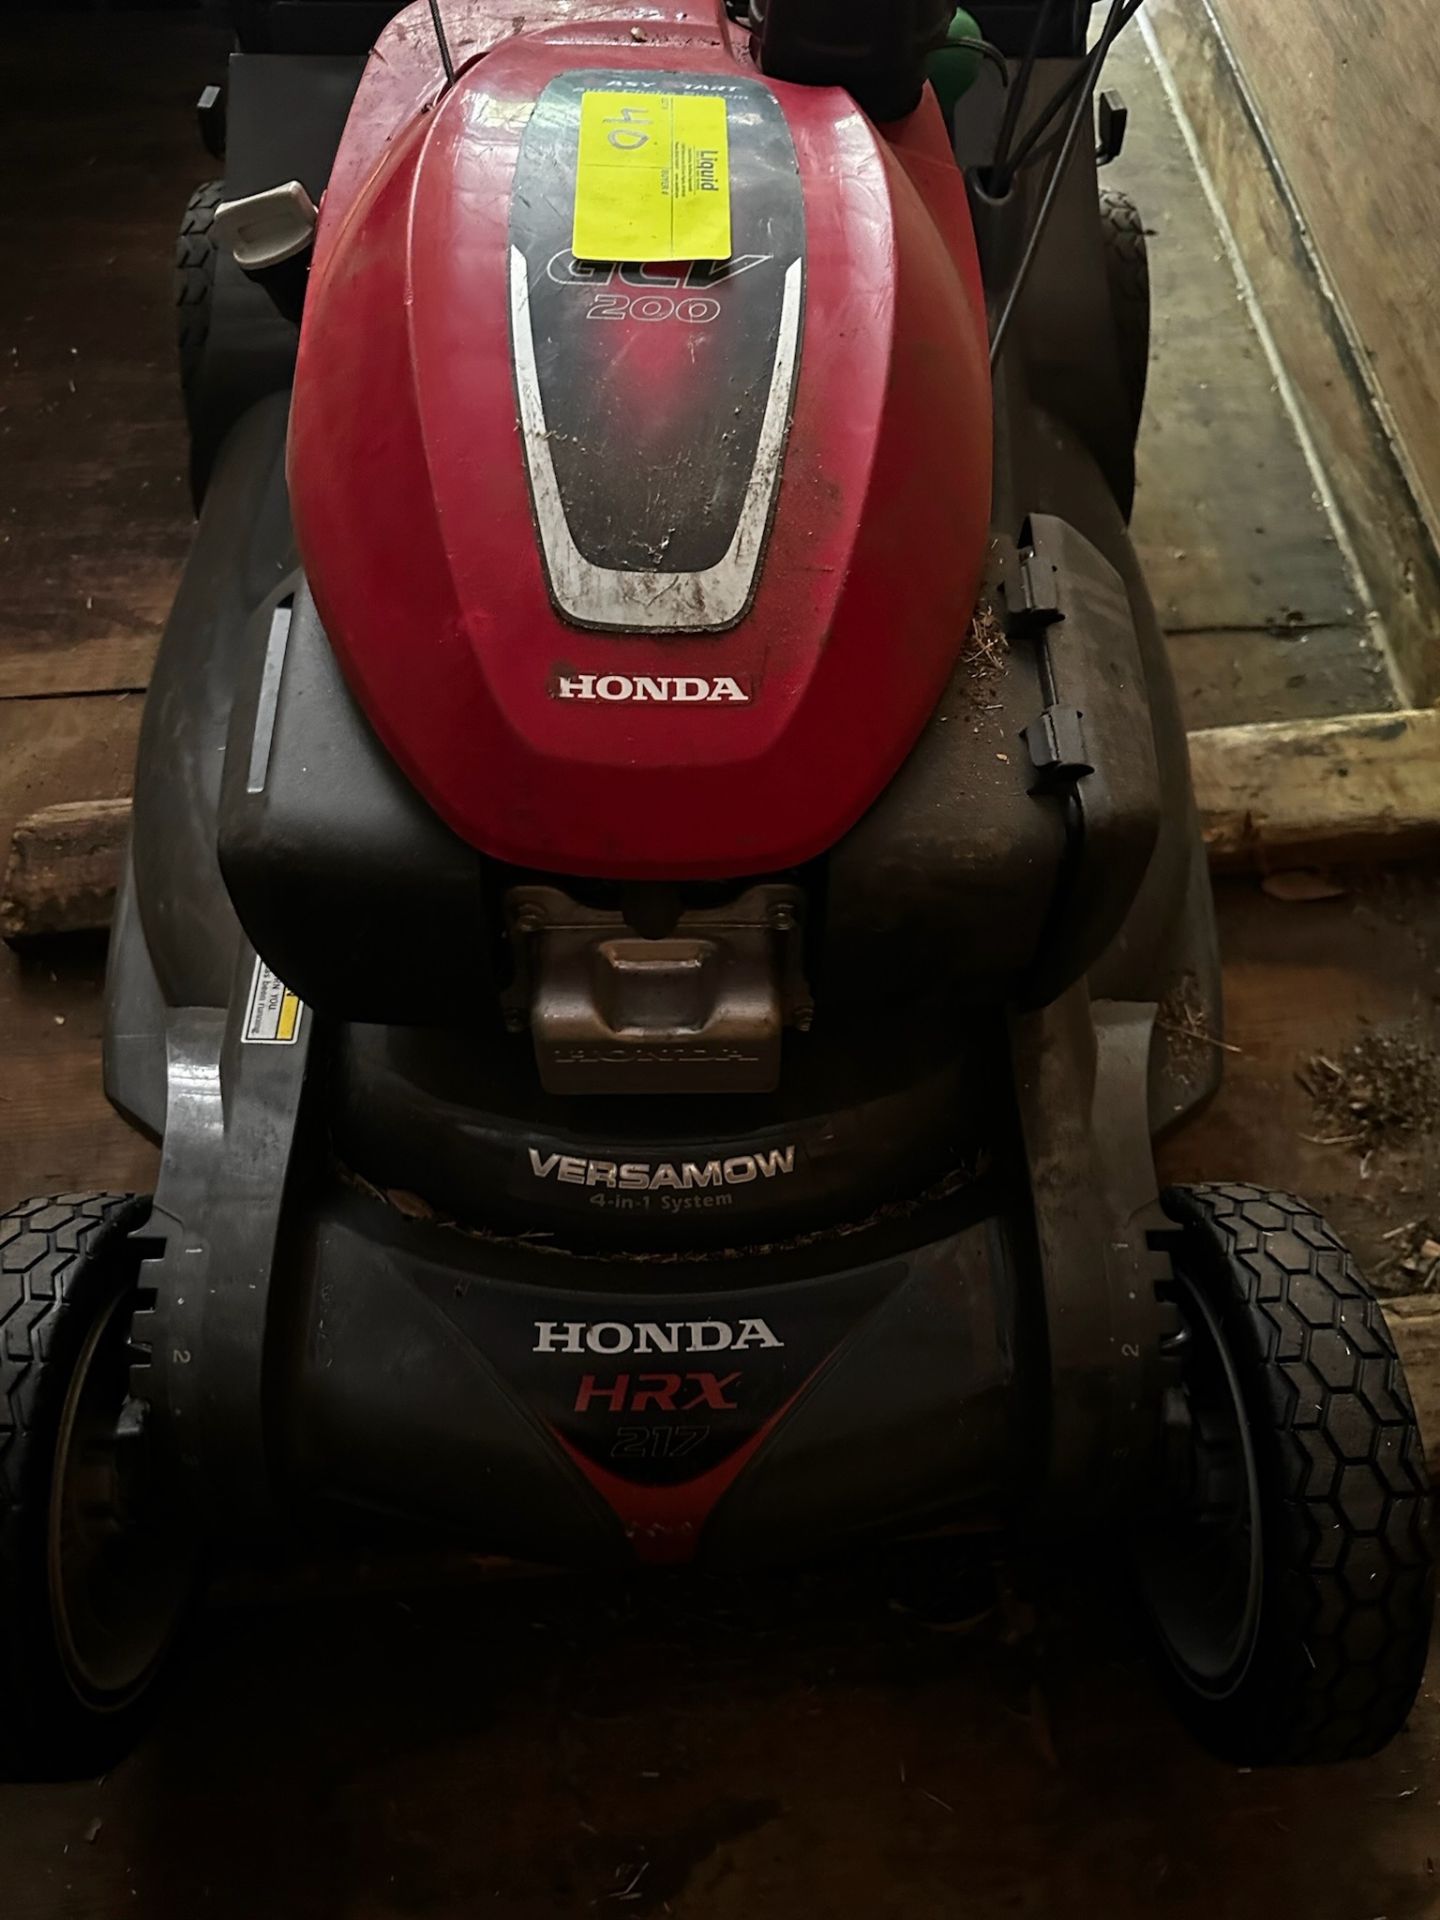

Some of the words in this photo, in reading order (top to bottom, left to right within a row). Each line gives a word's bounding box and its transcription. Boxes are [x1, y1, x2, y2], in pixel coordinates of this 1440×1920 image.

[601, 107, 653, 151] 40
[699, 150, 719, 192] Liquid
[586, 294, 720, 323] 200
[558, 674, 749, 702] HONDA
[268, 995, 278, 1010] YOU
[553, 1048, 759, 1063] HONDA
[527, 1144, 796, 1190] VERSAMOW
[589, 1192, 650, 1210] 4-in-1
[661, 1192, 733, 1214] System
[532, 1317, 785, 1355] HONDA
[1120, 1343, 1140, 1358] 2
[172, 1349, 191, 1364] 2
[574, 1371, 743, 1412] HRX
[609, 1425, 711, 1458] 217
